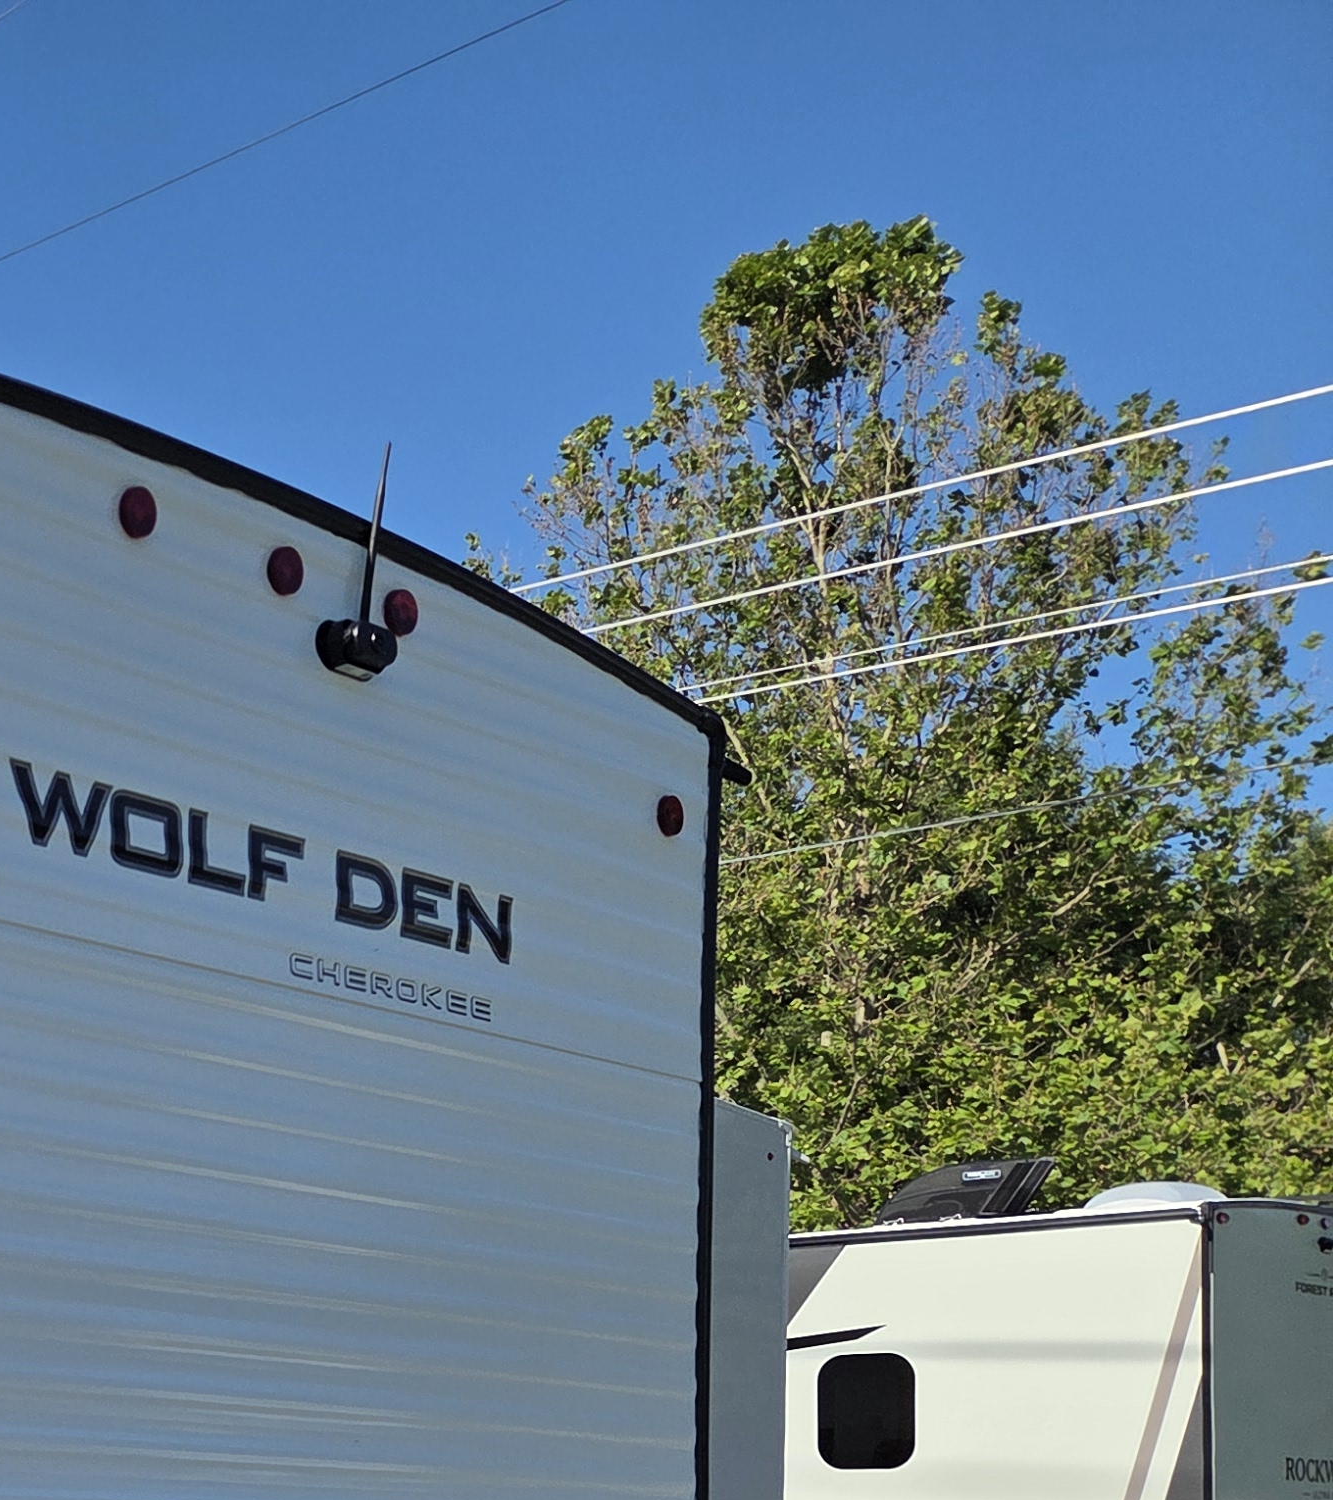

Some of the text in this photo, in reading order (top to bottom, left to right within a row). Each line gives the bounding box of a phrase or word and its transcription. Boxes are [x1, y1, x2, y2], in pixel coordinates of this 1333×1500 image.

[9, 756, 514, 965] WOLF DEN
[288, 952, 493, 1022] CHEROKEE
